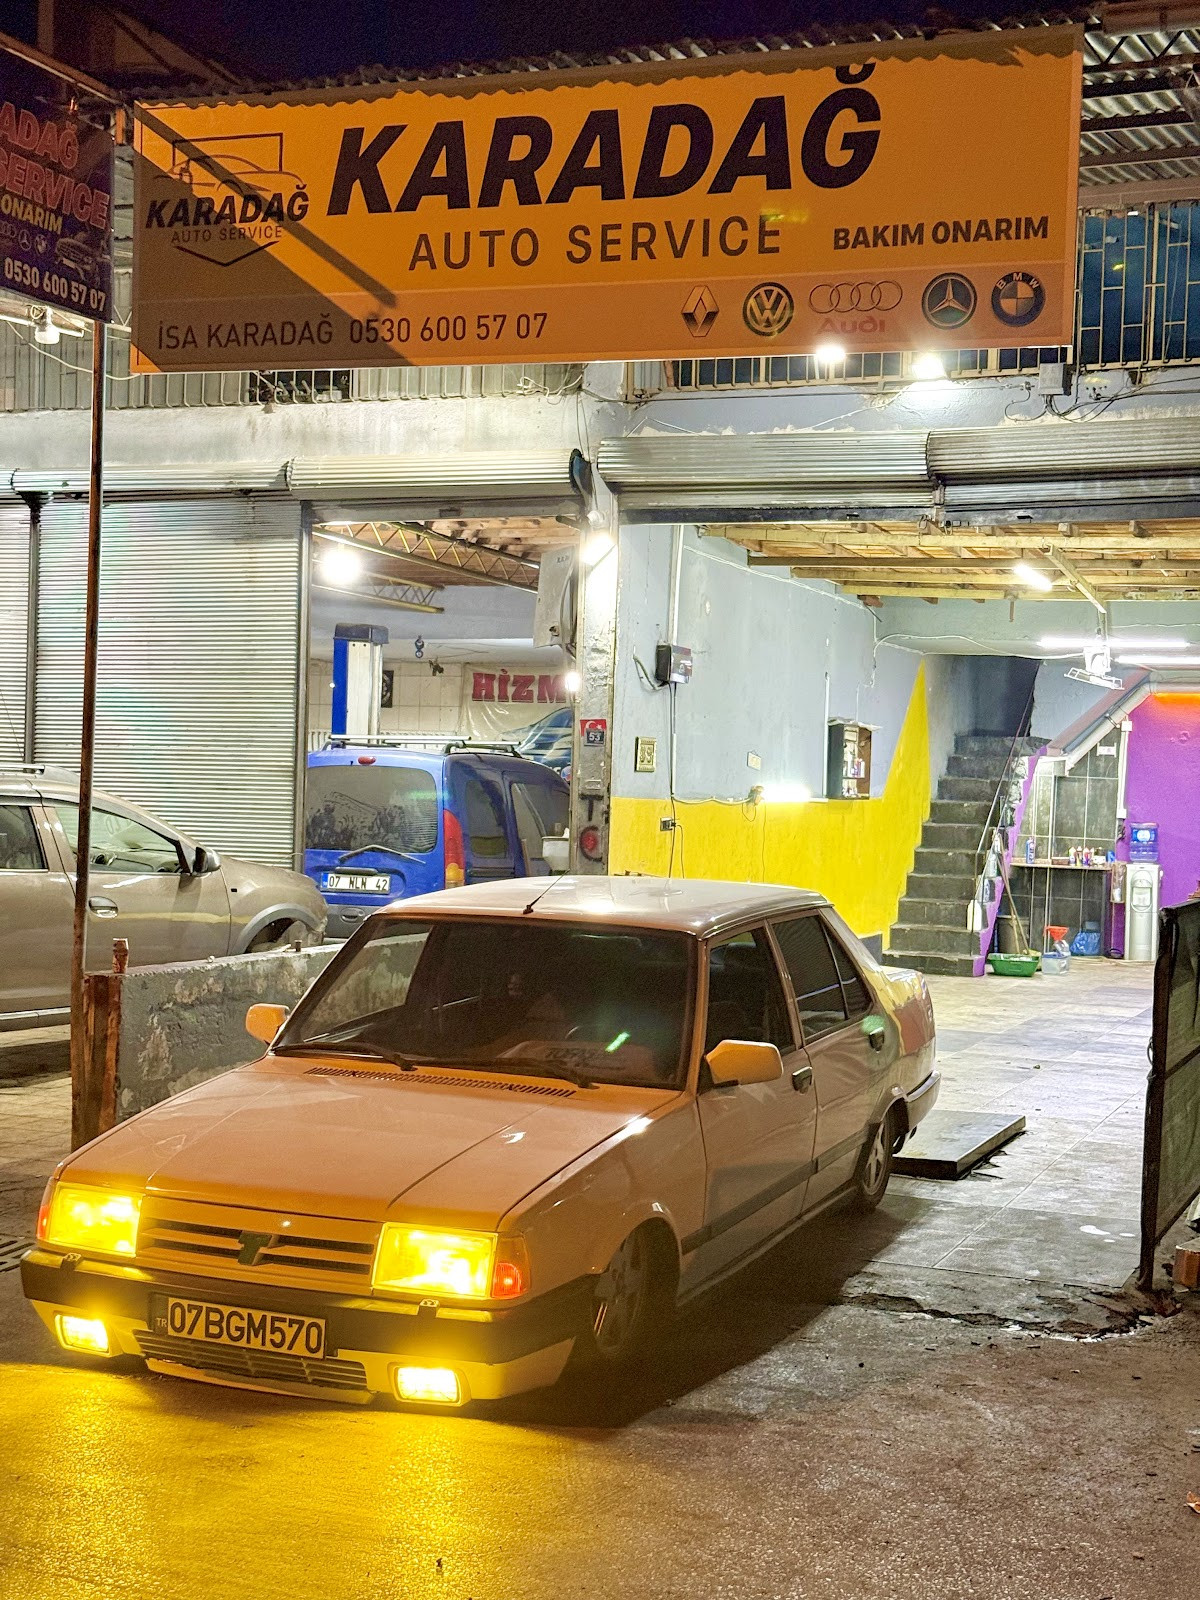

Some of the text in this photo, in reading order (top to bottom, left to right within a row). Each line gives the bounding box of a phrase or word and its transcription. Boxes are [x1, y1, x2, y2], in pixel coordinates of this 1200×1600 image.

[326, 61, 882, 216] KARADAĞ
[2, 193, 63, 235] ONARIM
[145, 183, 310, 229] KARADAĞ
[171, 225, 283, 244] AUTO SERVICE
[408, 213, 782, 272] AUTO SERVICE
[833, 215, 1050, 251] BAKIM ONARIM
[4, 256, 107, 313] 0530 600 57 07
[157, 312, 548, 350] İSA KARADAĞ 0530 600 57 07
[816, 315, 886, 335] Audi
[328, 875, 341, 888] 07
[375, 878, 388, 891] 42
[155, 1301, 323, 1355] TR 07BGM570
